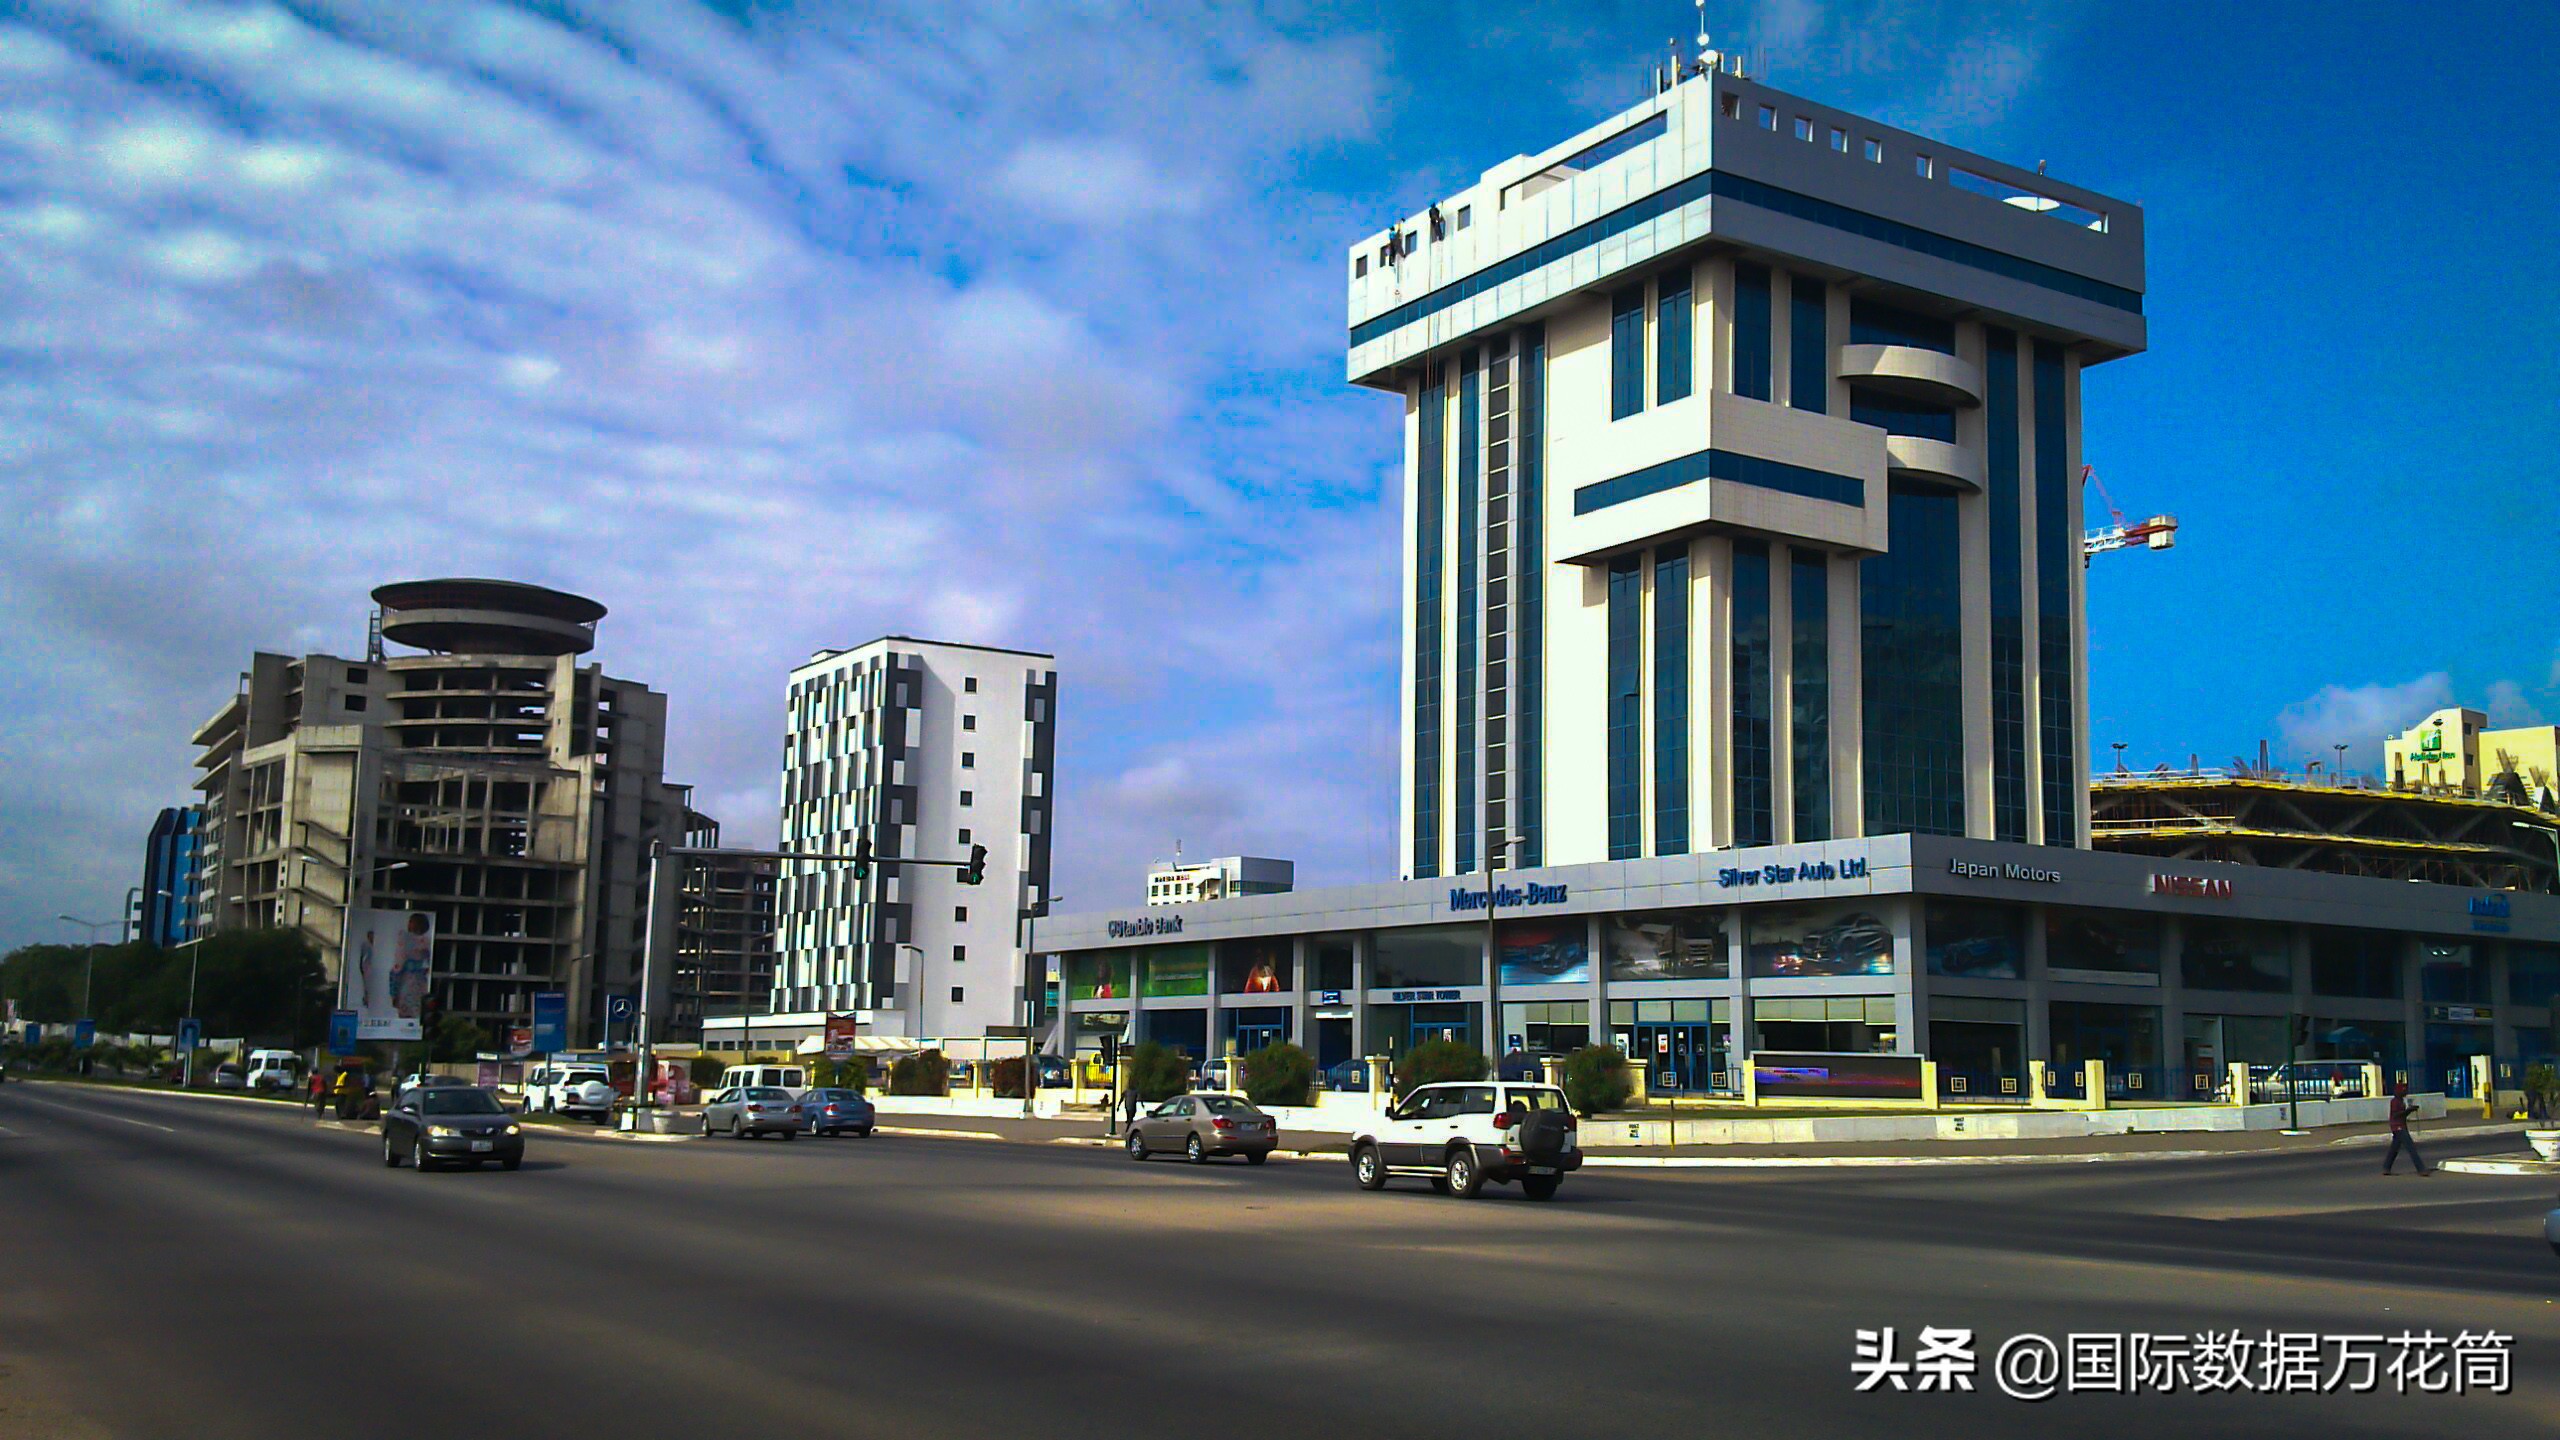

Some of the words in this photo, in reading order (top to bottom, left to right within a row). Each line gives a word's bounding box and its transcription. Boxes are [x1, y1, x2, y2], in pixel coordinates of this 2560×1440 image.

[1718, 868, 1760, 888] Silver
[1763, 864, 1796, 885] Star
[1798, 861, 1835, 881] Auto
[1839, 857, 1871, 879] Ltd.
[1950, 858, 1999, 878] Japan
[2004, 863, 2060, 883] Motors
[2149, 874, 2232, 896] NISSAN
[1156, 915, 1183, 934] Bank
